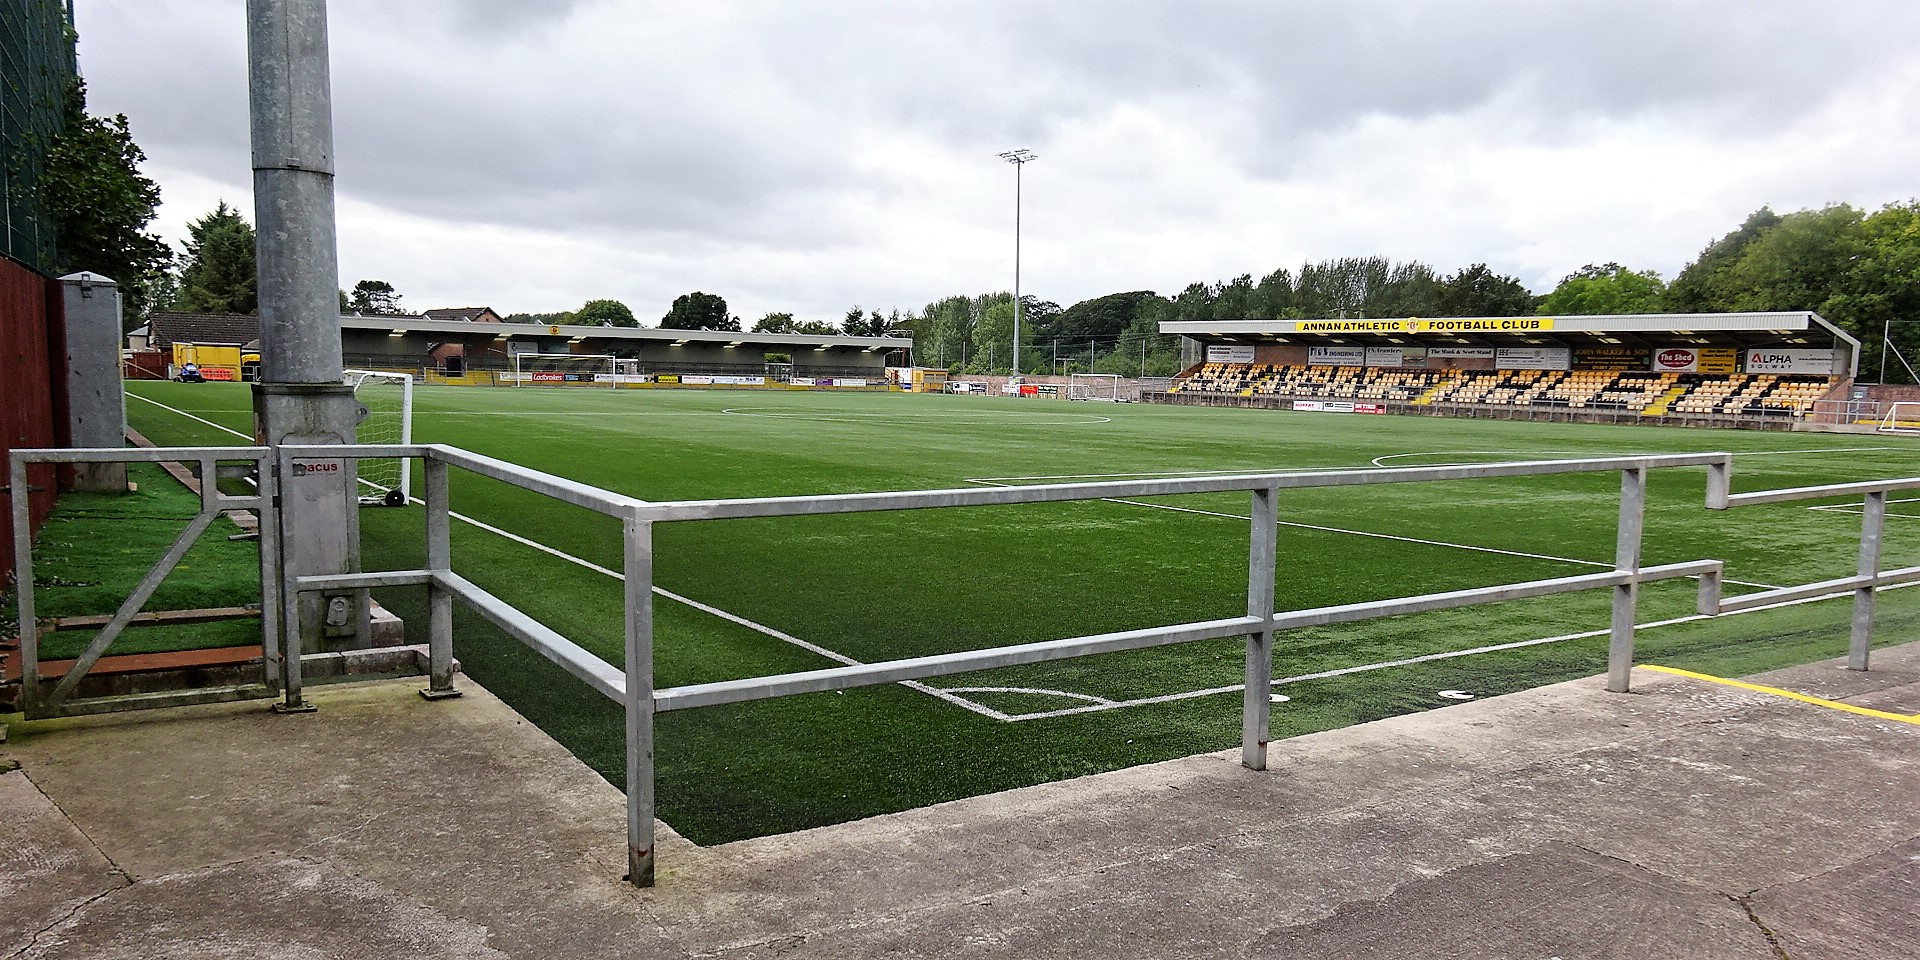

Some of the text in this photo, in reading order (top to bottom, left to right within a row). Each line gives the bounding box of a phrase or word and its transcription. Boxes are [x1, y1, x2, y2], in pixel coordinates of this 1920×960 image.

[1303, 320, 1540, 331] ANNAN ATHLETIC FOOTBALL CLUB
[1674, 353, 1692, 361] Shed
[1751, 353, 1792, 363] ALPHA
[294, 463, 338, 472] acus
